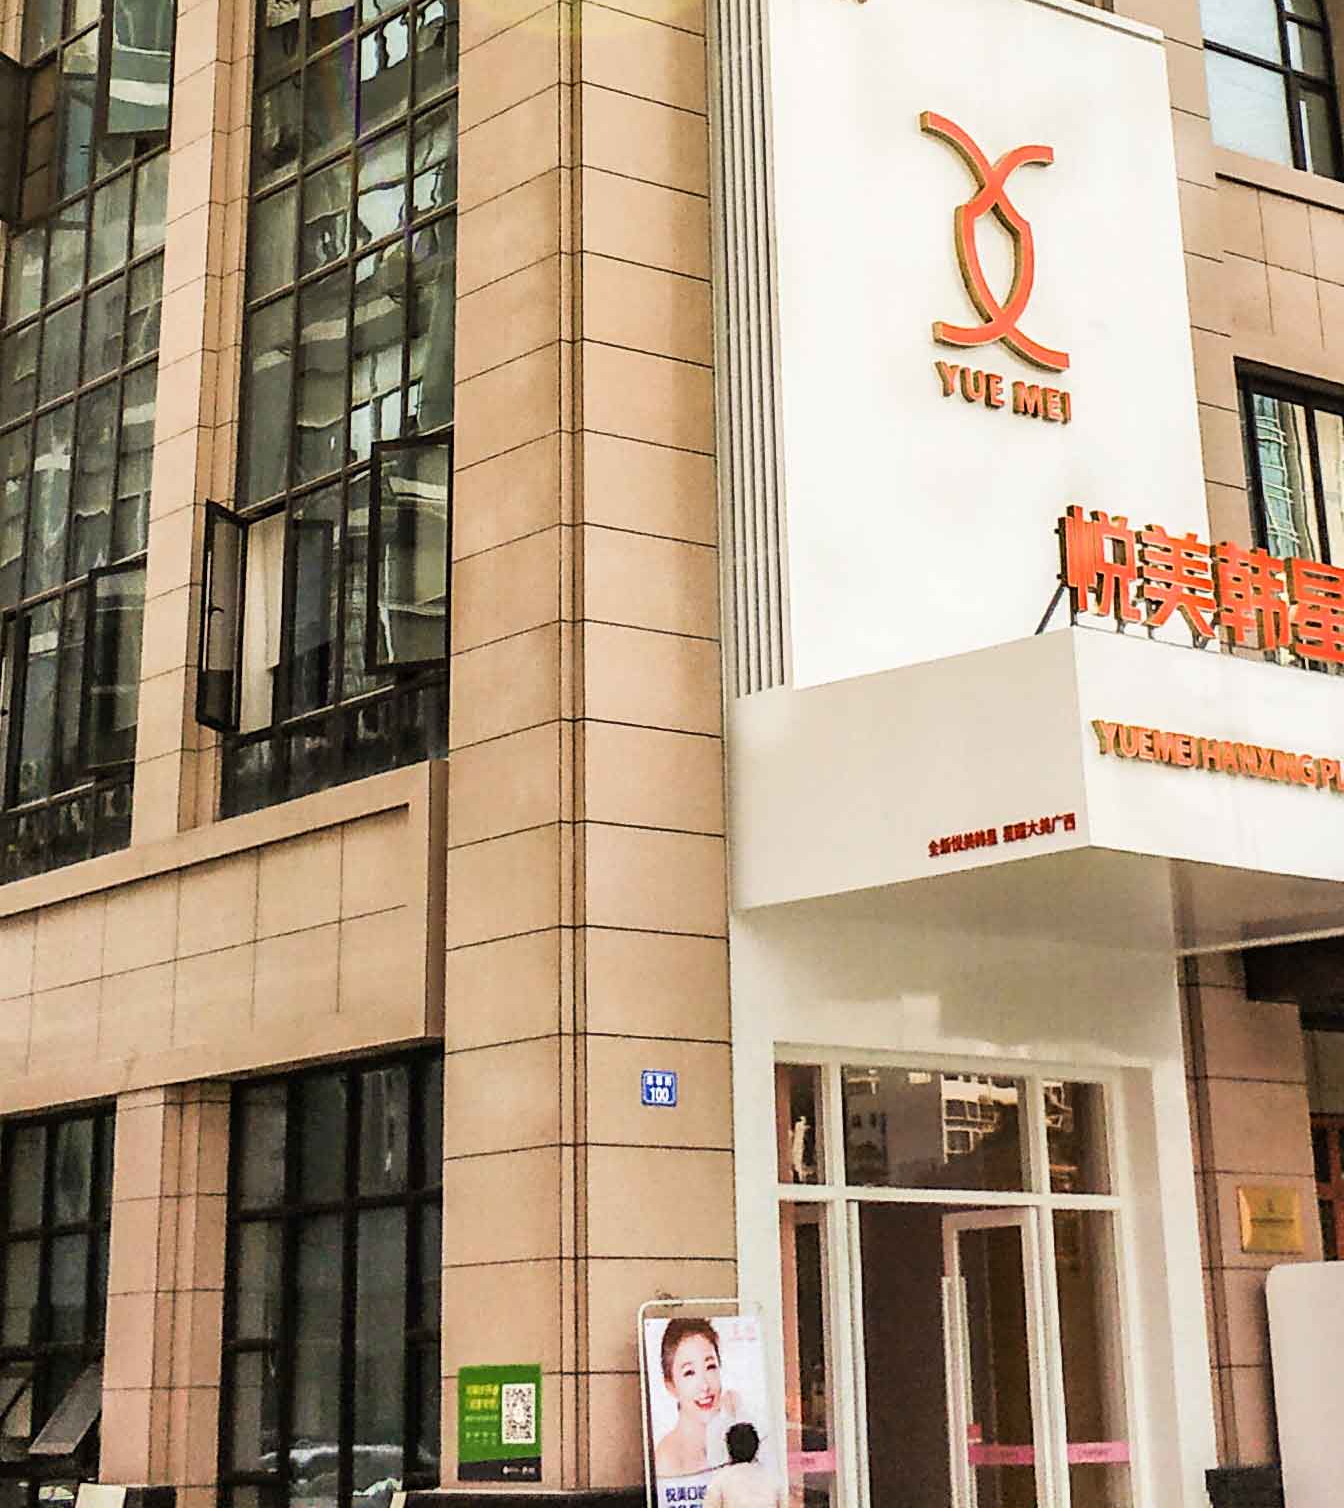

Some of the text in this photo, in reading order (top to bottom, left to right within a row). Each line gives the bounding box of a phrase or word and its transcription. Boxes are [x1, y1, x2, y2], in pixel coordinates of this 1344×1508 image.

[934, 361, 1072, 424] YUE MEI
[1092, 720, 1200, 769] YUEMEI
[1203, 739, 1317, 787] HANXING
[650, 1087, 669, 1101] 100
